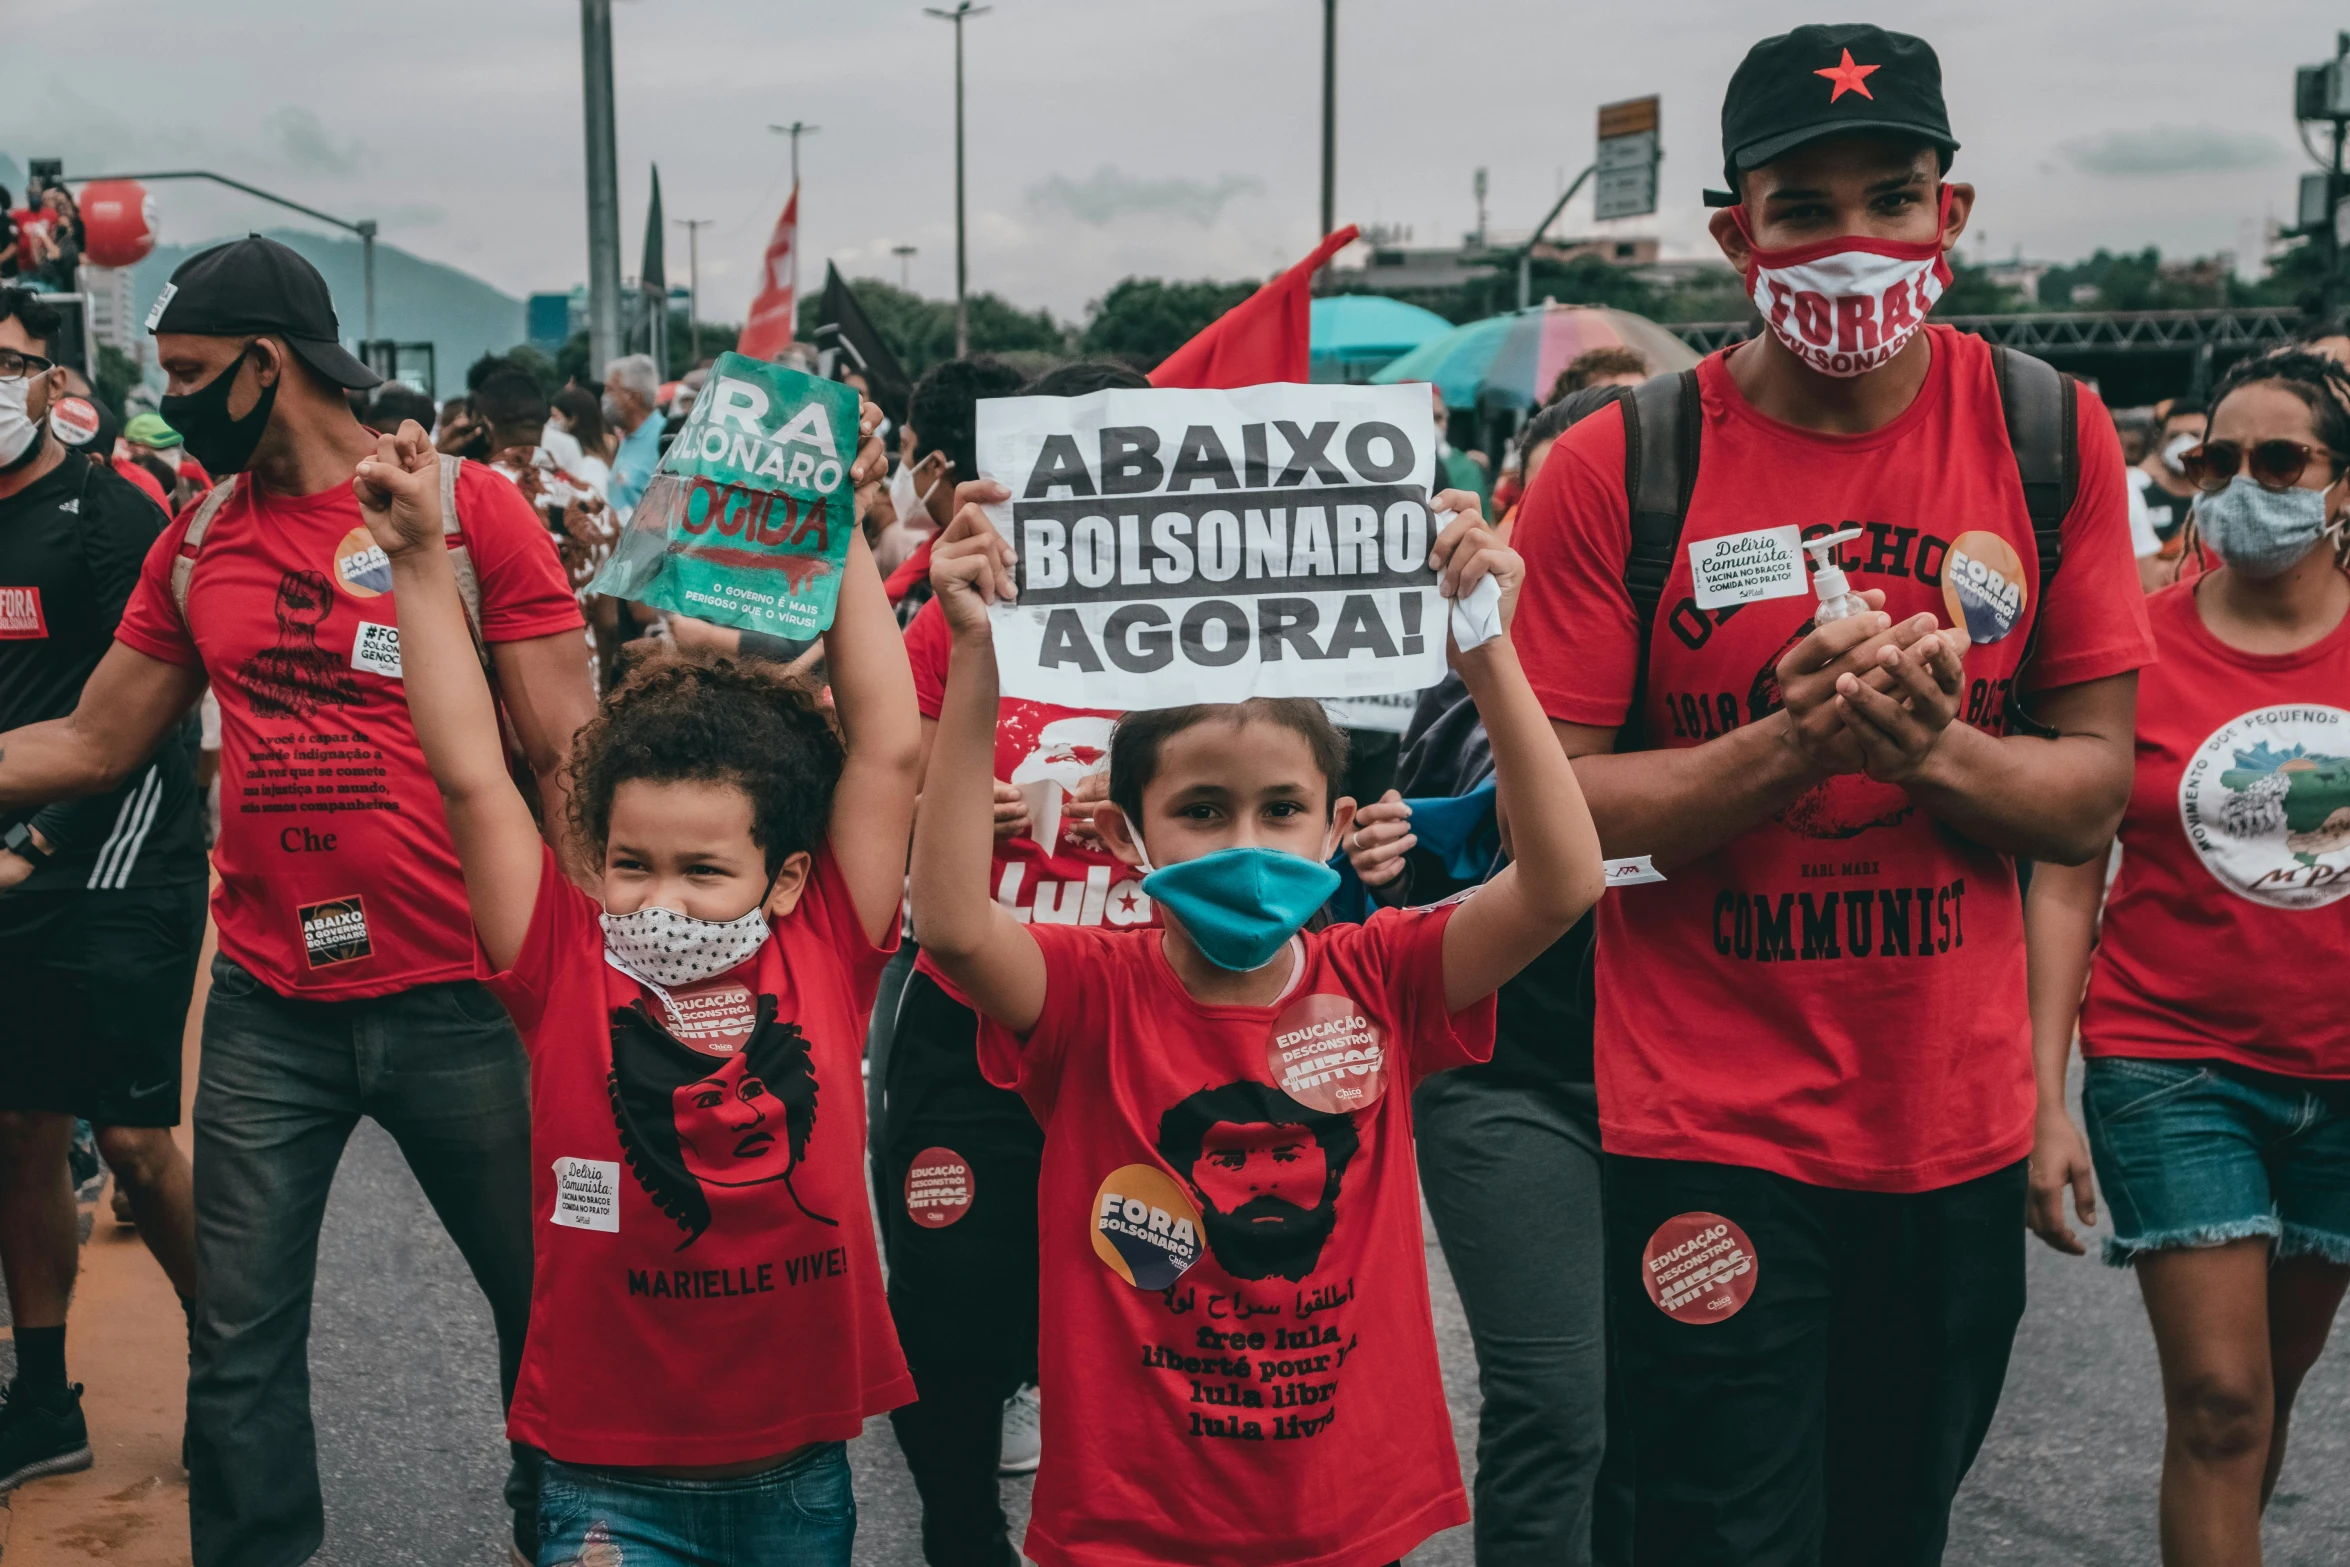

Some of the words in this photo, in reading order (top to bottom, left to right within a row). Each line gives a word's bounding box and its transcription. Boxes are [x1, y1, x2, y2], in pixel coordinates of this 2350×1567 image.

[1768, 269, 1932, 352] FORA!
[690, 375, 838, 458] ORA
[671, 426, 843, 494] OLSONARO
[1023, 420, 1416, 499] ABAIXO
[339, 545, 388, 572] FOR
[1024, 500, 1428, 591] BOLSONARO
[1715, 536, 1777, 557] Delírio
[1801, 519, 1950, 588] SCHO
[344, 557, 391, 579] BOLSONA
[1702, 547, 1793, 573] Comunista:
[1705, 571, 1739, 583] VACINA
[1740, 568, 1754, 577] NO
[1755, 563, 1786, 574] BRAÇO
[1786, 562, 1792, 570] E
[1709, 580, 1744, 593] COMIDA
[1744, 577, 1759, 587] NO
[1760, 572, 1791, 583] PRATO!
[1950, 549, 2019, 608] FORA
[0, 588, 37, 617] FORA
[713, 583, 722, 592] O
[725, 586, 775, 606] GOVERNO
[777, 593, 786, 608] É
[789, 601, 818, 615] MAIS
[1948, 569, 2016, 620] BOLSONARO!
[685, 591, 738, 611] PERIGOSO
[741, 603, 761, 617] QUE
[765, 609, 774, 619] O
[778, 612, 816, 629] VÍRUS!
[363, 639, 400, 653] BOLSON
[365, 625, 399, 643] #FO
[1037, 591, 1425, 674] AGORA!
[361, 650, 400, 664] GENOC
[309, 732, 348, 745] capaz
[352, 731, 369, 743] de
[294, 749, 370, 762] indignação
[374, 752, 383, 760] a
[290, 769, 314, 780] que
[318, 768, 332, 777] se
[336, 766, 386, 777] comete
[2186, 758, 2214, 852] MOVIMENTO
[2209, 727, 2238, 751] DOS
[2244, 710, 2340, 728] PEQUENOS
[262, 783, 312, 797] injustiça
[316, 785, 333, 795] no
[337, 782, 390, 795] mundo,
[300, 799, 399, 814] companheiros
[280, 827, 337, 853] Che
[998, 861, 1153, 926] Lula
[304, 911, 363, 933] ABAIXO
[305, 932, 313, 941] O
[315, 922, 366, 939] GOVERNO
[1712, 878, 1965, 962] COMMUNIST
[306, 929, 366, 949] BOLSONARO
[667, 1004, 751, 1021] DSCONSTRÓI
[1275, 1015, 1367, 1049] EDUCAÇÃO
[1281, 1032, 1374, 1063] DESCONSTRÓI
[1281, 1046, 1385, 1093] MITOS
[1335, 1087, 1362, 1099] Chico
[569, 1162, 602, 1179] Delírio
[911, 1165, 965, 1178] EDUCAÇÃO
[911, 1177, 965, 1188] DESCONSTRÓI
[562, 1174, 613, 1195] Comunista:
[587, 1196, 605, 1205] BRAÇO
[589, 1206, 610, 1215] PRATO!
[1100, 1193, 1195, 1246] FORA
[1098, 1218, 1194, 1260] BOLSONARO!
[1648, 1224, 1728, 1273] EDUCAÇÃO
[627, 1263, 775, 1298] MARIELLE
[785, 1245, 848, 1287] VIVE!
[1655, 1237, 1736, 1285] DESCONSTRÓI
[1659, 1248, 1753, 1312] MITOS
[1706, 1296, 1731, 1310] Chico
[1196, 1326, 1266, 1351] free
[1274, 1325, 1341, 1350] lula
[1141, 1345, 1251, 1379] liberté
[1258, 1353, 1330, 1382] pour
[1189, 1380, 1264, 1408] lula
[1188, 1412, 1264, 1440] lula
